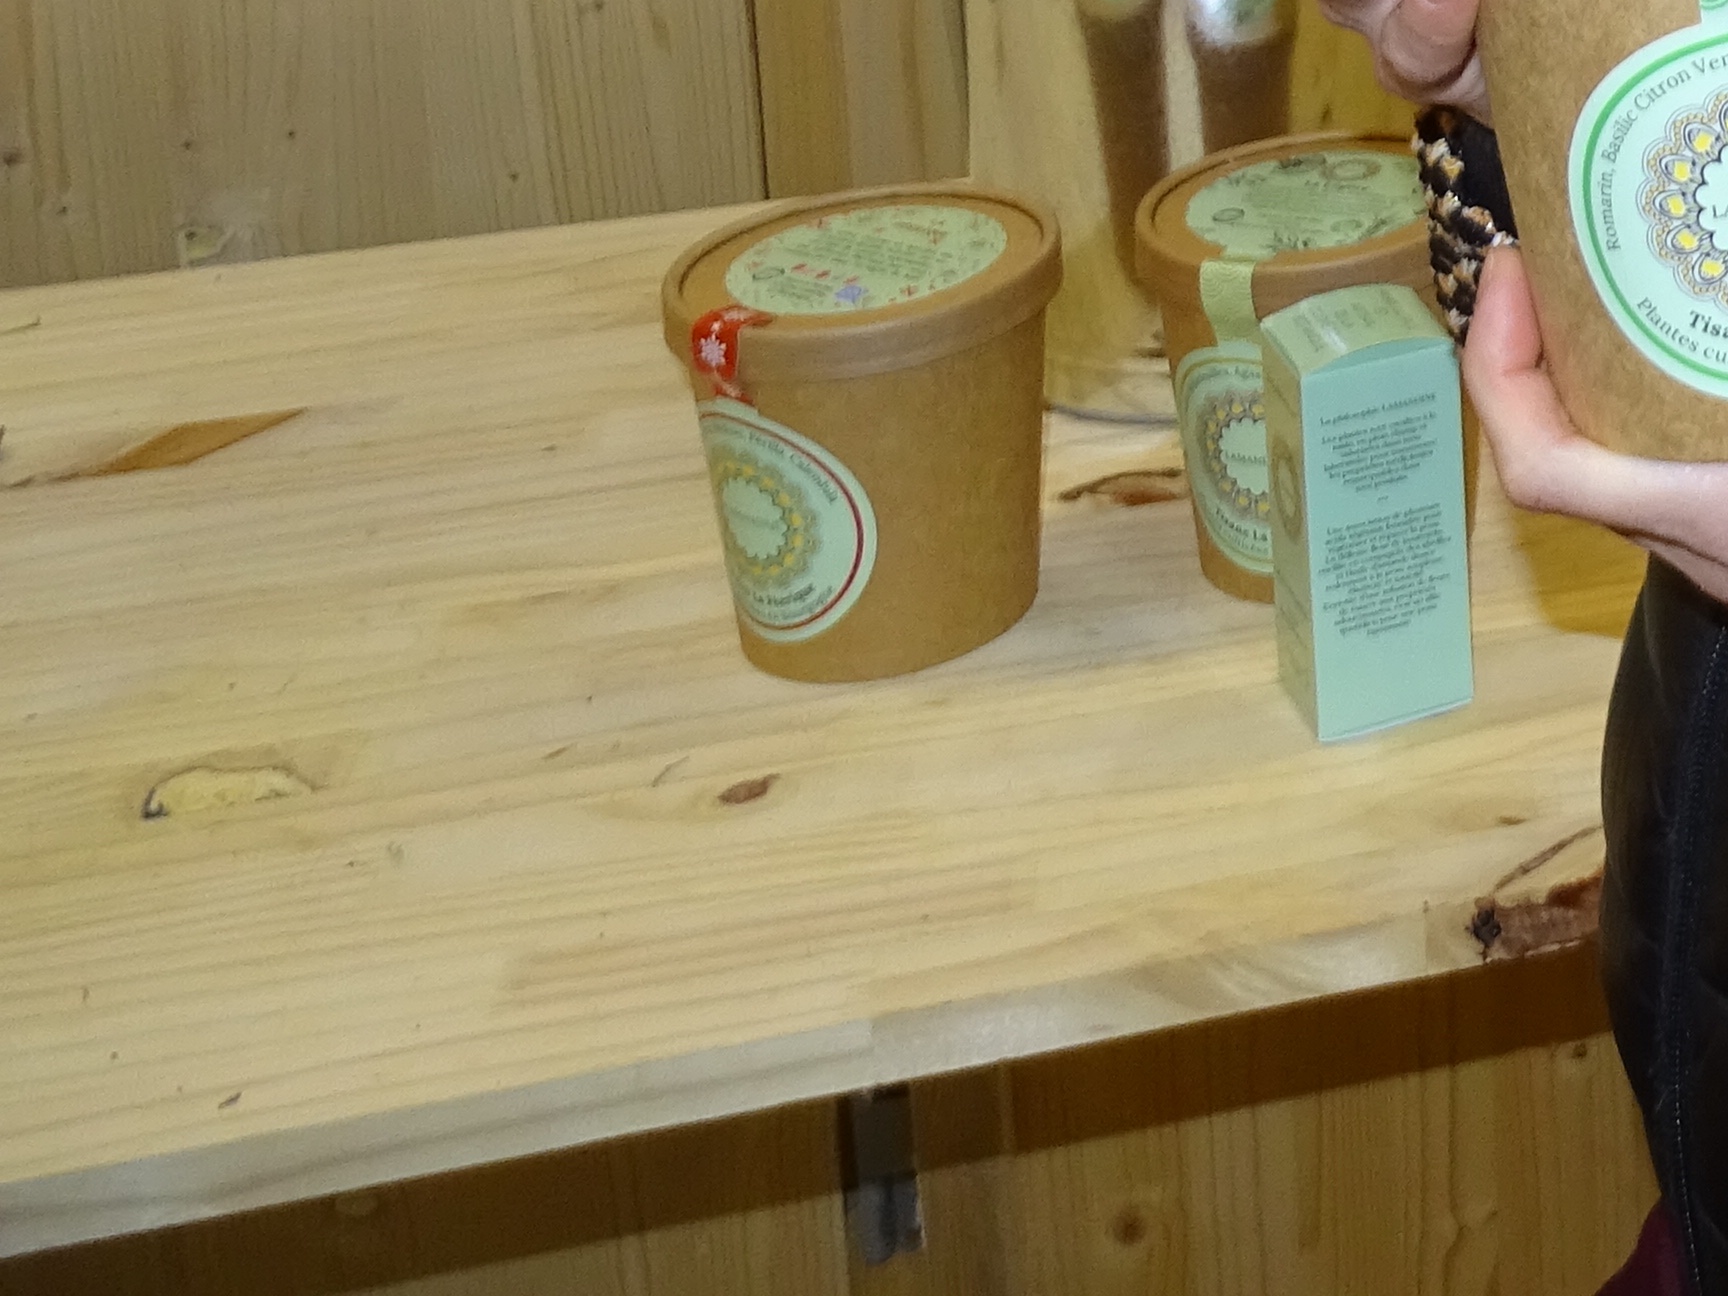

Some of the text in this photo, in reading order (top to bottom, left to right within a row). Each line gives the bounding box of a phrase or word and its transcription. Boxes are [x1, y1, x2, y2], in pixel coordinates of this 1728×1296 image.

[1633, 70, 1692, 112] Citron
[1602, 108, 1638, 166] Basilic
[1601, 165, 1622, 252] Romarin,
[1636, 296, 1700, 353] Plantes
